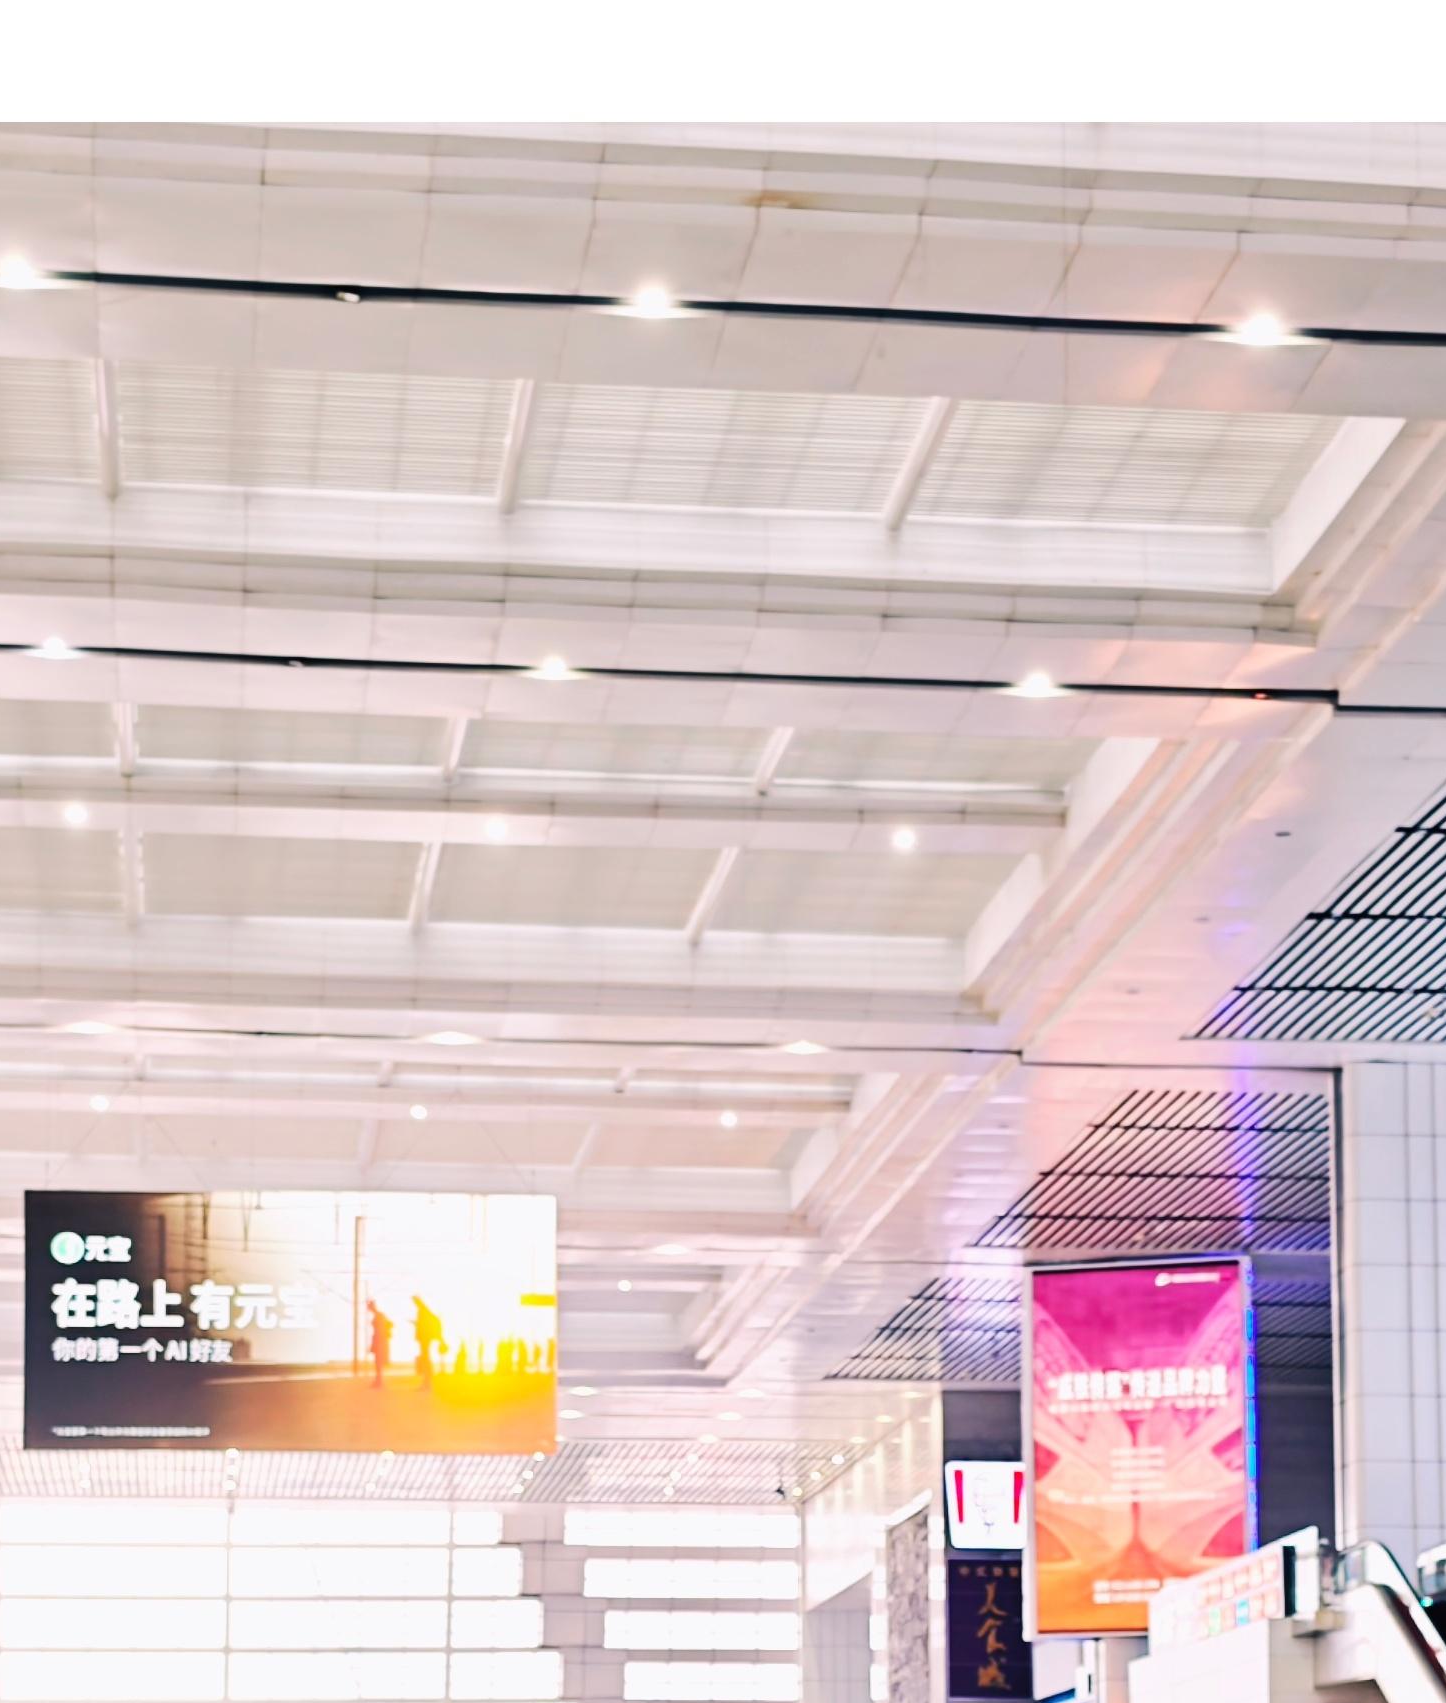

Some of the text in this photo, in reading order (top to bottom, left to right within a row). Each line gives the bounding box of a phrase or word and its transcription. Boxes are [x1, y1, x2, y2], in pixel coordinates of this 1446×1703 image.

[84, 1235, 131, 1262] 元宝
[51, 1277, 321, 1330] 在路上 有元宝
[52, 1337, 233, 1362] 你的第一个AI好友
